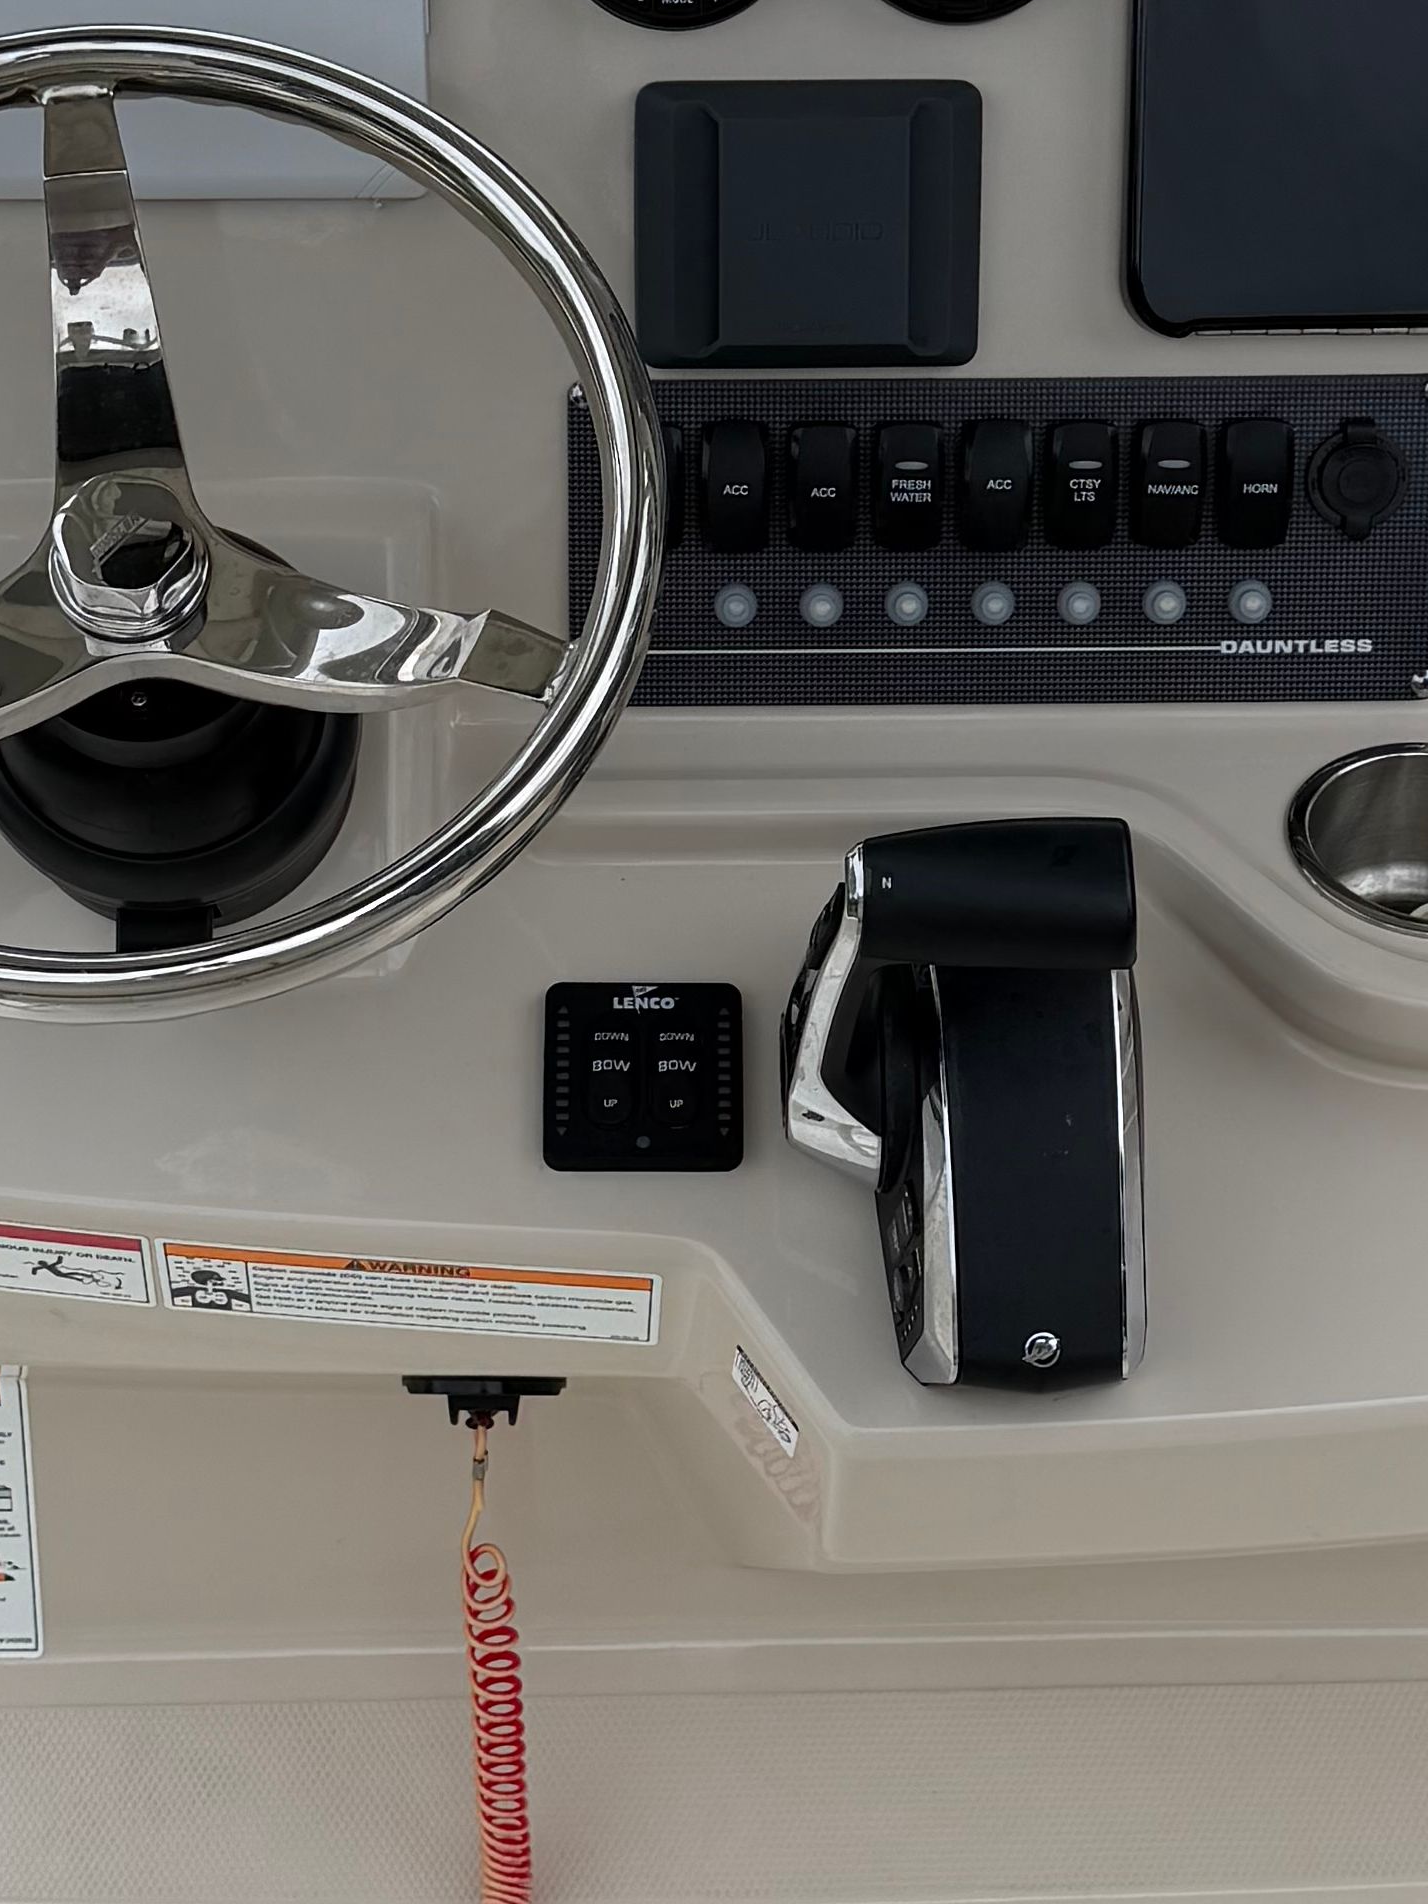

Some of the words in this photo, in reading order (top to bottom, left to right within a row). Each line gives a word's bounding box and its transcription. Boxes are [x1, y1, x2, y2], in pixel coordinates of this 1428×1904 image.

[891, 479, 931, 490] FRESH
[987, 479, 1012, 490] ACC
[1070, 478, 1101, 490] CTSY
[1243, 483, 1278, 494] HORN
[723, 484, 749, 496] ACC
[811, 487, 836, 498] ACC
[891, 491, 932, 503] WATER
[1074, 491, 1095, 502] LTS
[1221, 639, 1373, 654] DAUNTLESS
[882, 876, 892, 889] N
[613, 997, 675, 1010] LENCO
[594, 1032, 629, 1041] DOWN
[659, 1032, 695, 1041] DOWN
[592, 1059, 630, 1072] BOW
[658, 1059, 697, 1072] BOW
[603, 1099, 618, 1108] UP
[669, 1099, 684, 1109] UP
[370, 1262, 470, 1278] WARNING
